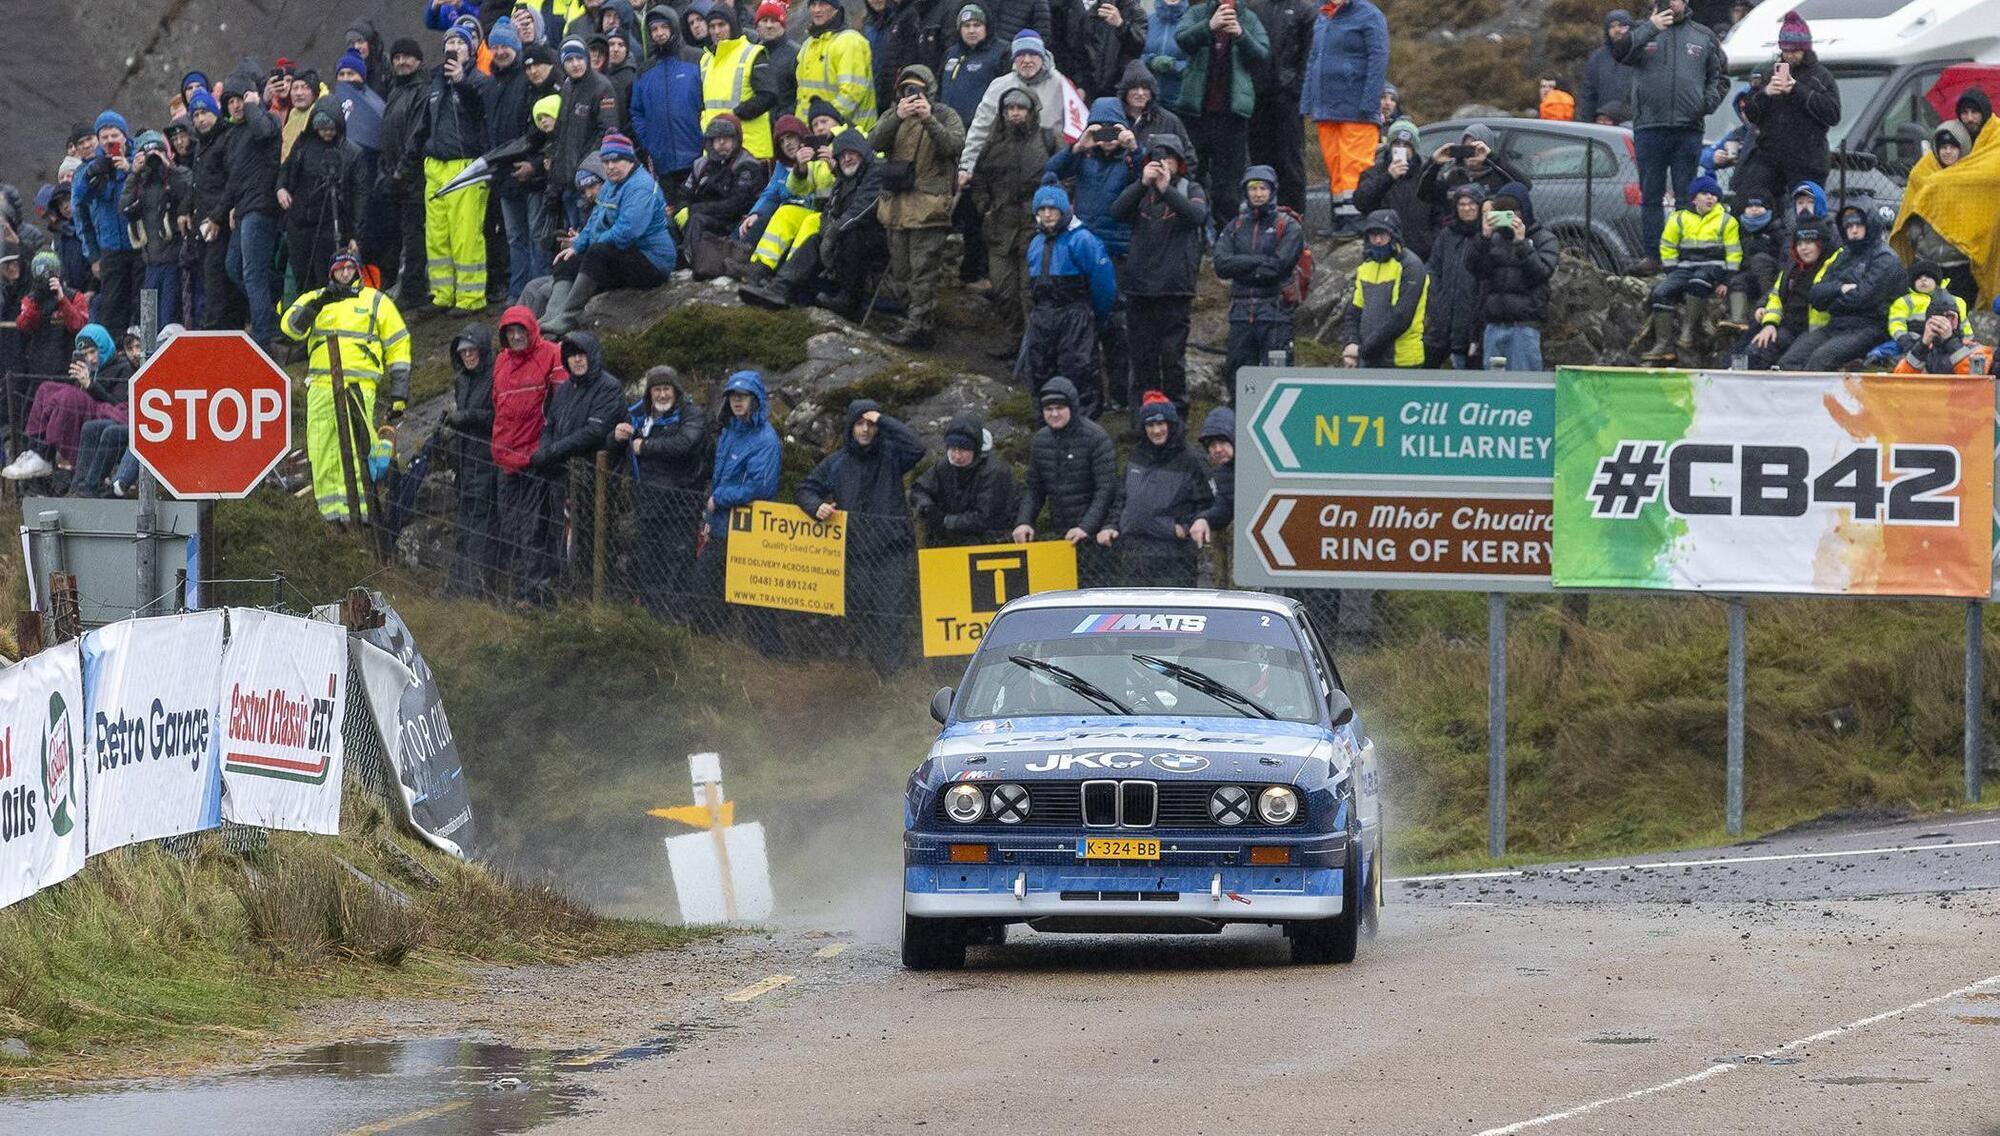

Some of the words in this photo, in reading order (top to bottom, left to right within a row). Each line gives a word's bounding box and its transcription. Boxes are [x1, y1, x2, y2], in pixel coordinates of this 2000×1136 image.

[139, 388, 282, 443] STOP
[1400, 400, 1447, 425] Cill
[1400, 434, 1553, 460] KILLARNEY
[1587, 440, 1961, 527] #CB42
[759, 510, 842, 540] Traynors
[1368, 504, 1443, 530] Mhór
[761, 539, 788, 553] Quality
[789, 543, 808, 554] Used
[808, 545, 821, 555] Car
[822, 546, 841, 558] Parts
[1320, 537, 1397, 562] RING
[1409, 538, 1449, 562] OF
[730, 555, 747, 566] FREE
[747, 557, 781, 570] DELIVERY
[781, 561, 810, 573] ACROSS
[811, 565, 840, 577] IRELAND
[773, 576, 784, 588] 38
[786, 578, 818, 592] 891242
[936, 617, 988, 642] Tra
[1109, 614, 1208, 633] MATS
[1260, 615, 1271, 628] 2
[228, 682, 272, 744] Castrol
[269, 688, 309, 750] Classic
[308, 698, 336, 754] GTX
[96, 706, 146, 774] Retro
[150, 697, 209, 773] Garage
[1025, 751, 1145, 772] JKC
[2, 784, 36, 843] Oils
[1086, 841, 1157, 856] K-324-BB
